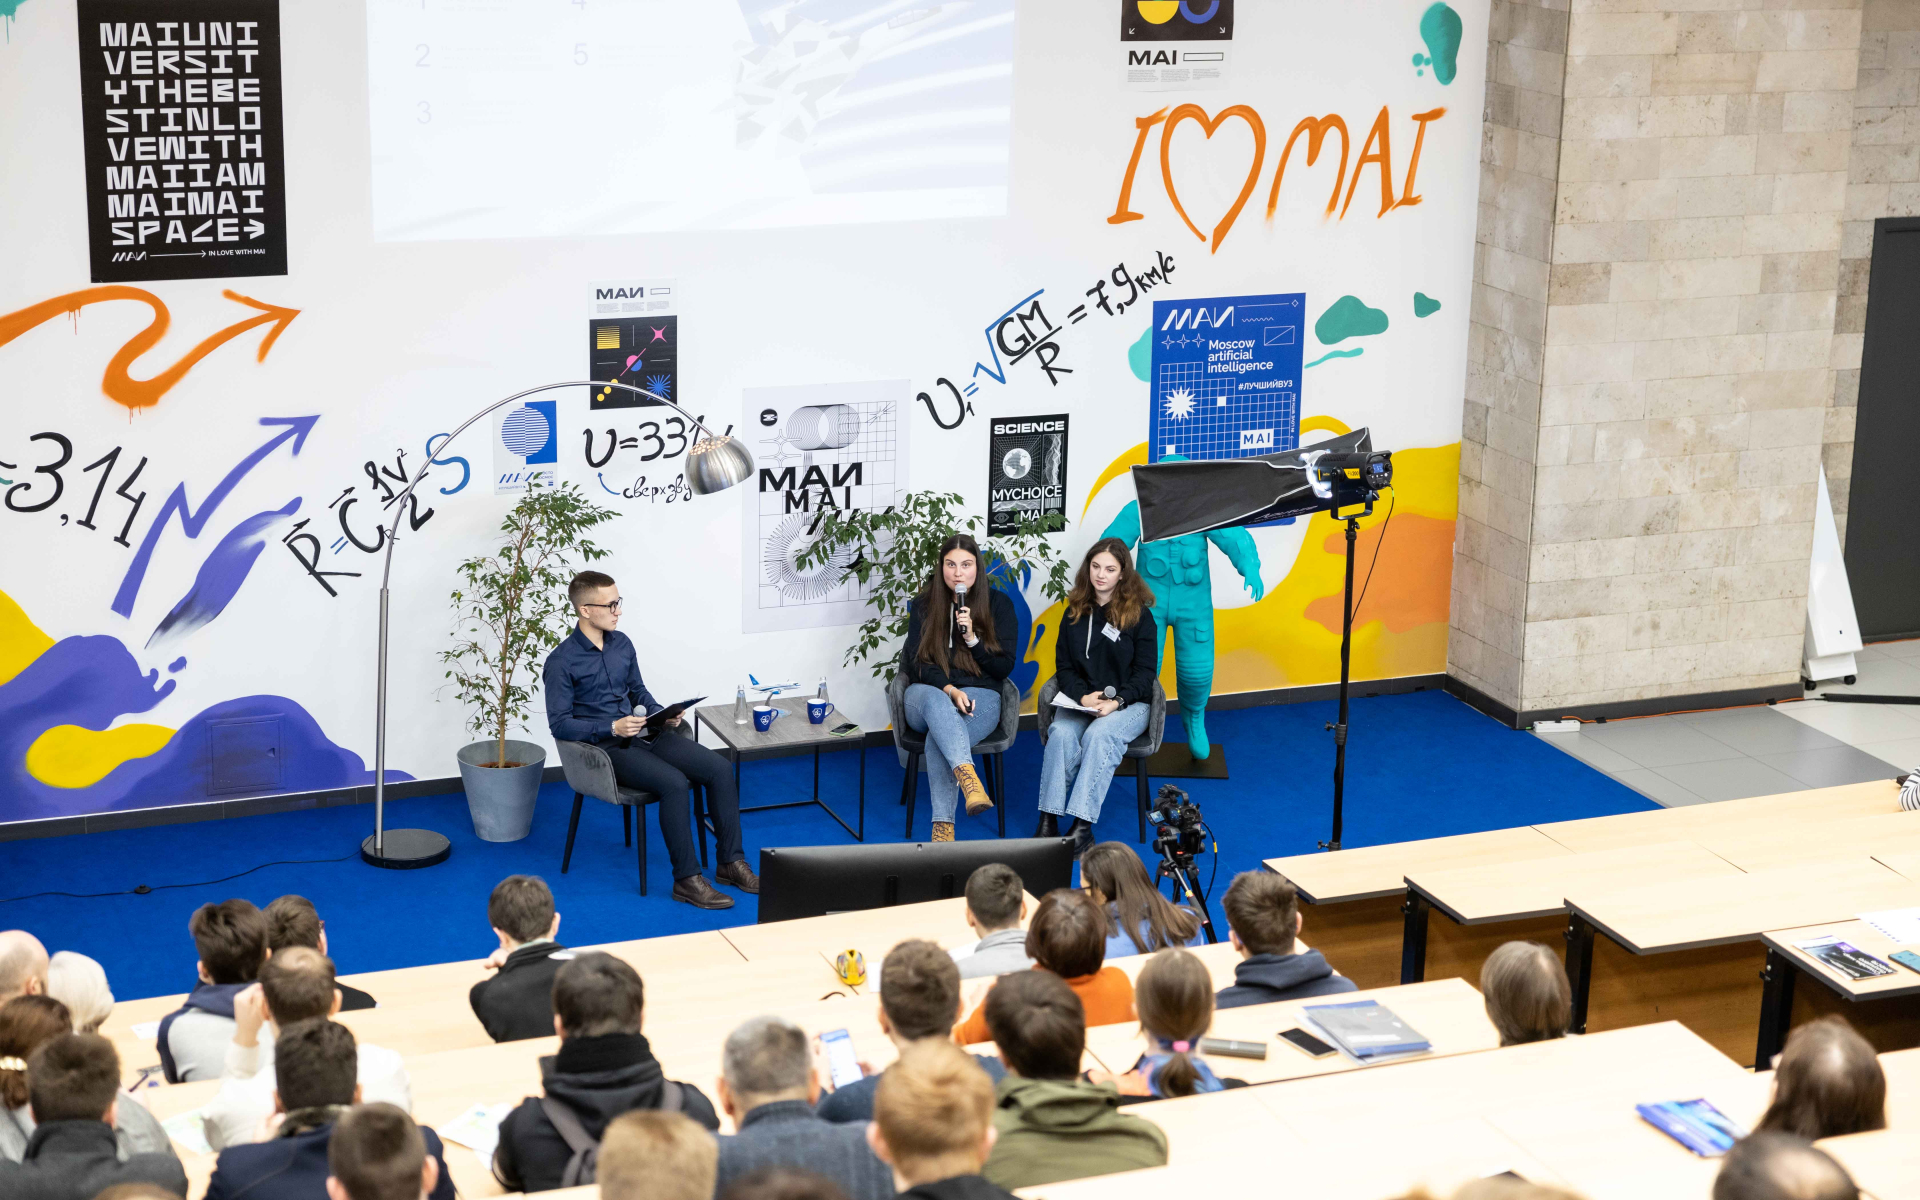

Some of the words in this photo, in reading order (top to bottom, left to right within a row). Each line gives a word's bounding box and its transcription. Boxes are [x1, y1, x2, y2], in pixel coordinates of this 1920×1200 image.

[100, 22, 258, 46] MAIUNI
[103, 50, 259, 75] VERSIT
[1128, 50, 1177, 66] MAI
[104, 79, 260, 104] YTHEBE
[106, 107, 261, 133] STINLO
[107, 134, 262, 161] VEWITH
[106, 162, 266, 190] MAIIAM
[107, 190, 264, 218] MAIMAI
[596, 286, 644, 300] МАИ
[1208, 349, 1253, 362] artificial
[1209, 339, 1255, 350] Moscow
[1208, 361, 1273, 374] intelligence
[1238, 379, 1293, 391] #ЛУЧШИЙВУЗ
[994, 421, 1065, 435] SCIENCE
[1243, 432, 1271, 445] MAI
[622, 473, 693, 504] сверхзву
[759, 462, 862, 492] МАИ
[785, 486, 851, 514] MAI
[992, 486, 1063, 501] MYCHOICE
